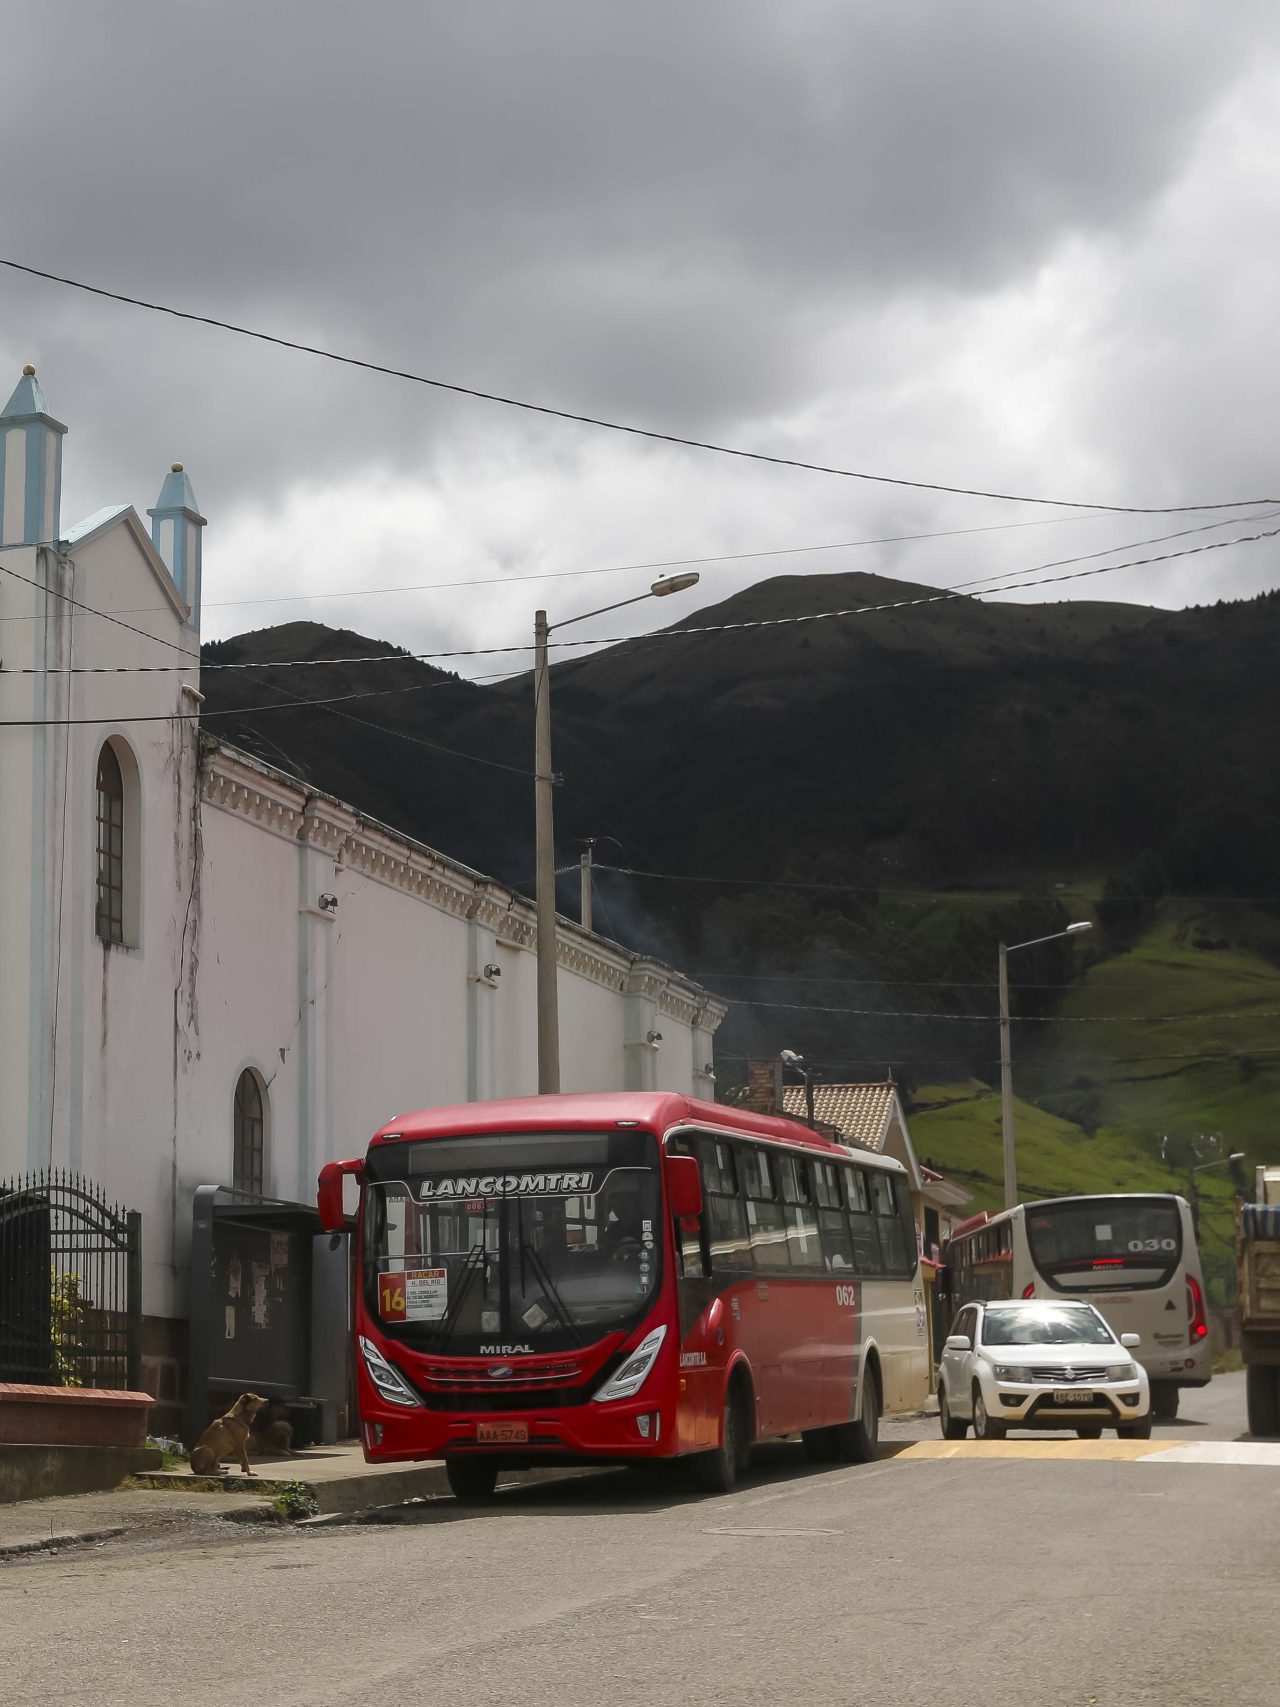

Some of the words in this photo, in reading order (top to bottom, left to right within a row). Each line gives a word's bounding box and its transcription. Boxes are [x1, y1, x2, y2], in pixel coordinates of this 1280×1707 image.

[421, 1172, 593, 1199] LANCOMTRI
[1128, 1239, 1176, 1251] 030
[411, 1271, 439, 1279] RACAR
[382, 1288, 405, 1312] 16
[836, 1285, 855, 1306] 062
[480, 1345, 534, 1354] MIRAL
